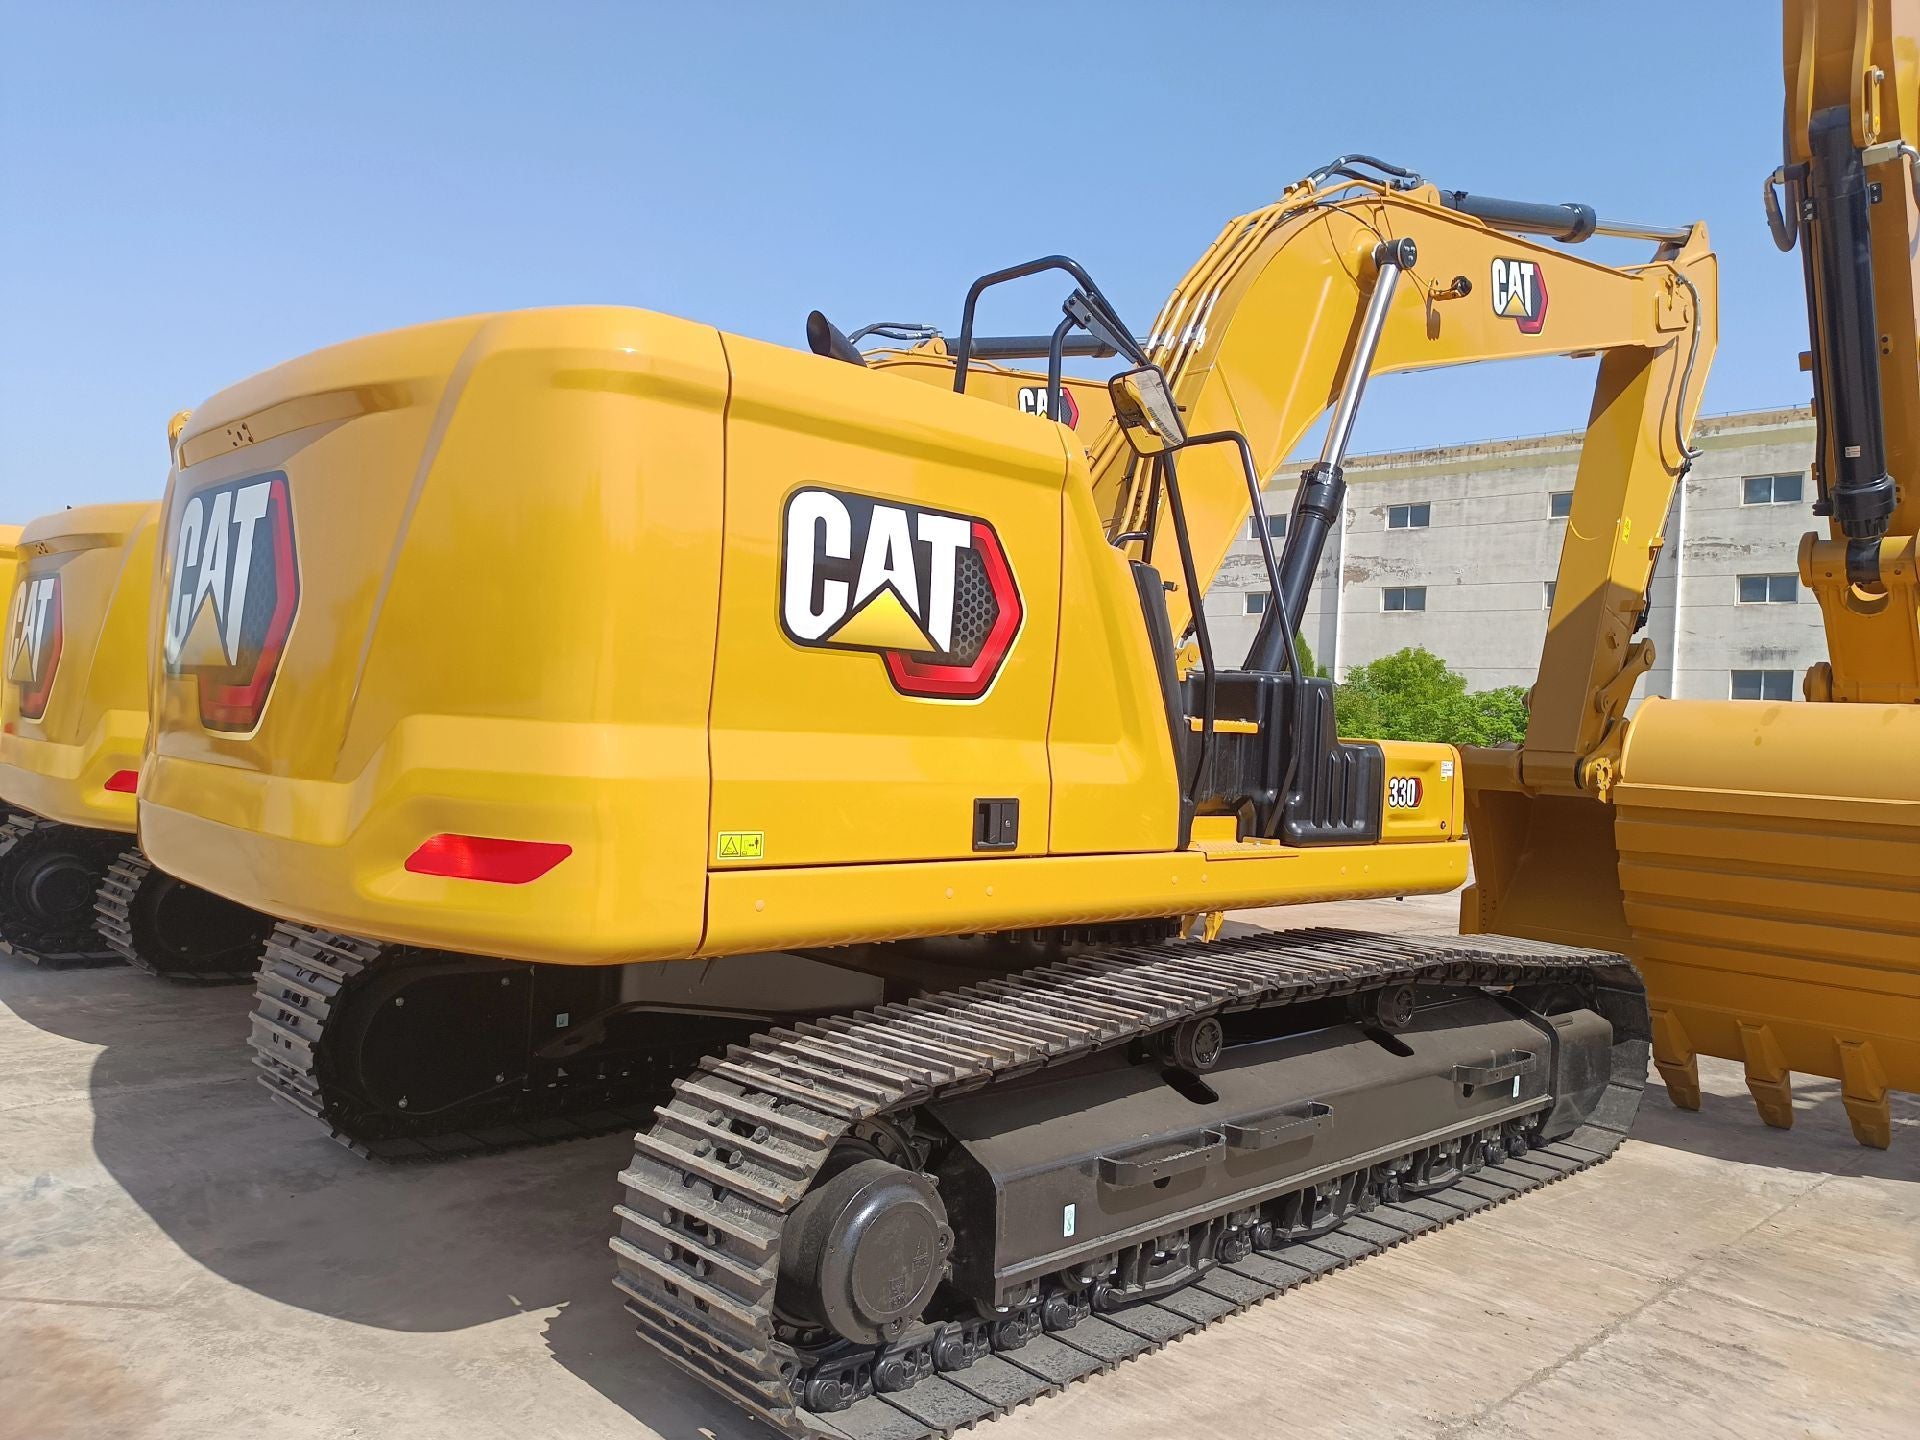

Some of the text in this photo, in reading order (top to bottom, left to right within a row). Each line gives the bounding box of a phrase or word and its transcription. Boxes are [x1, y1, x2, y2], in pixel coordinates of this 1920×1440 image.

[1492, 258, 1534, 317] CAT
[1019, 388, 1064, 423] CA
[167, 481, 271, 666] CAT
[785, 491, 972, 653] CAT
[8, 578, 55, 682] CAT
[1388, 778, 1416, 807] 330
